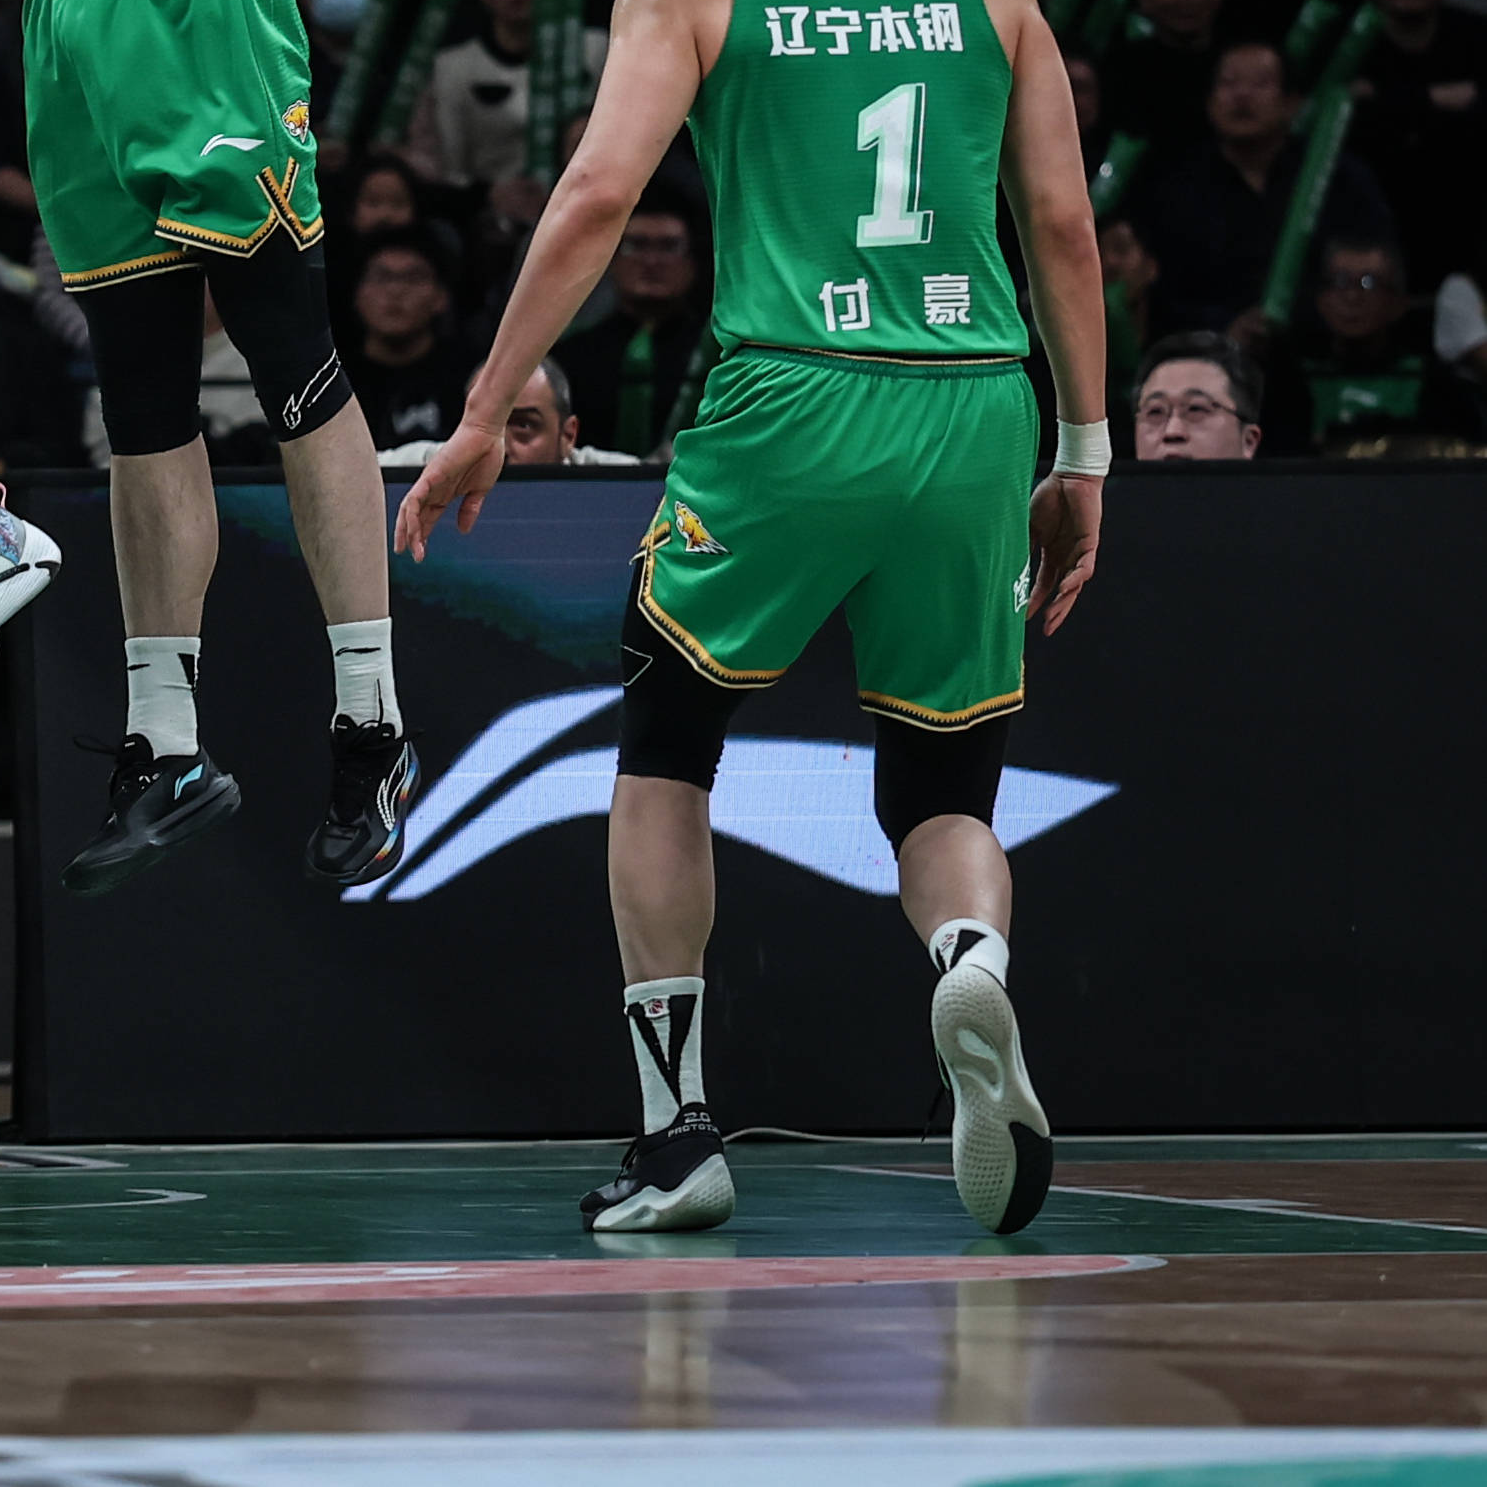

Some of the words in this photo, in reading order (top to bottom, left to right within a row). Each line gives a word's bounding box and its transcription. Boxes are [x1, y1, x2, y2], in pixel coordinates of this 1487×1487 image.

[765, 2, 965, 57] 辽宁本钢
[856, 82, 933, 248] 1
[818, 273, 972, 332] 付豪
